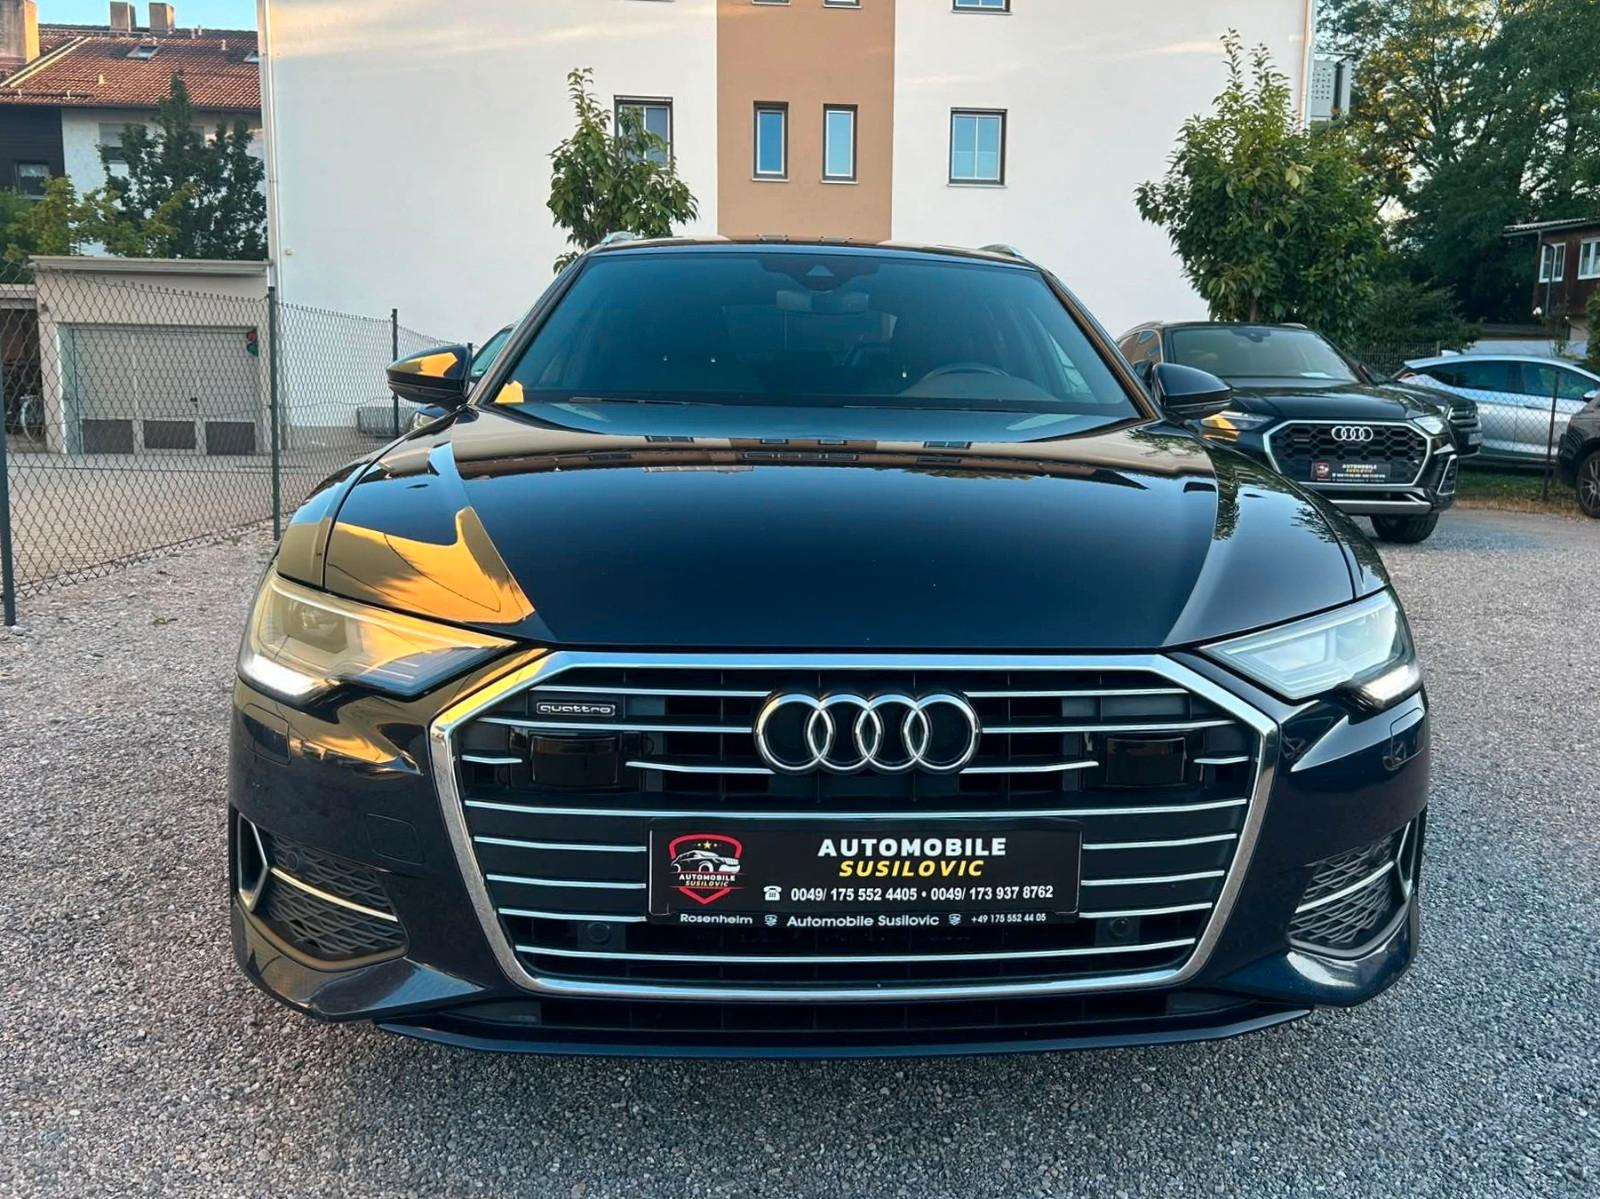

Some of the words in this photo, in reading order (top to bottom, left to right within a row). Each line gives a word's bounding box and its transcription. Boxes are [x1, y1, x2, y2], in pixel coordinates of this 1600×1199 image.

[540, 705, 611, 713] quattro
[817, 838, 1006, 857] AUTOMOBILE
[839, 860, 985, 877] SUSILOVIC
[791, 888, 827, 901] 0049/
[831, 888, 854, 901] 175
[858, 888, 882, 901] 552
[885, 888, 917, 901] 4405
[930, 888, 966, 900] 0049/
[969, 887, 993, 900] 173
[996, 887, 1020, 899] 937
[1022, 885, 1054, 899] 8762
[680, 914, 753, 925] Rosenheim
[786, 916, 874, 927] Automobile
[878, 915, 940, 926] Susilovic
[971, 915, 988, 924] +49
[990, 914, 1006, 924] 175
[1007, 914, 1023, 923] 552
[1023, 914, 1034, 922] 44
[1035, 913, 1047, 922] 05
